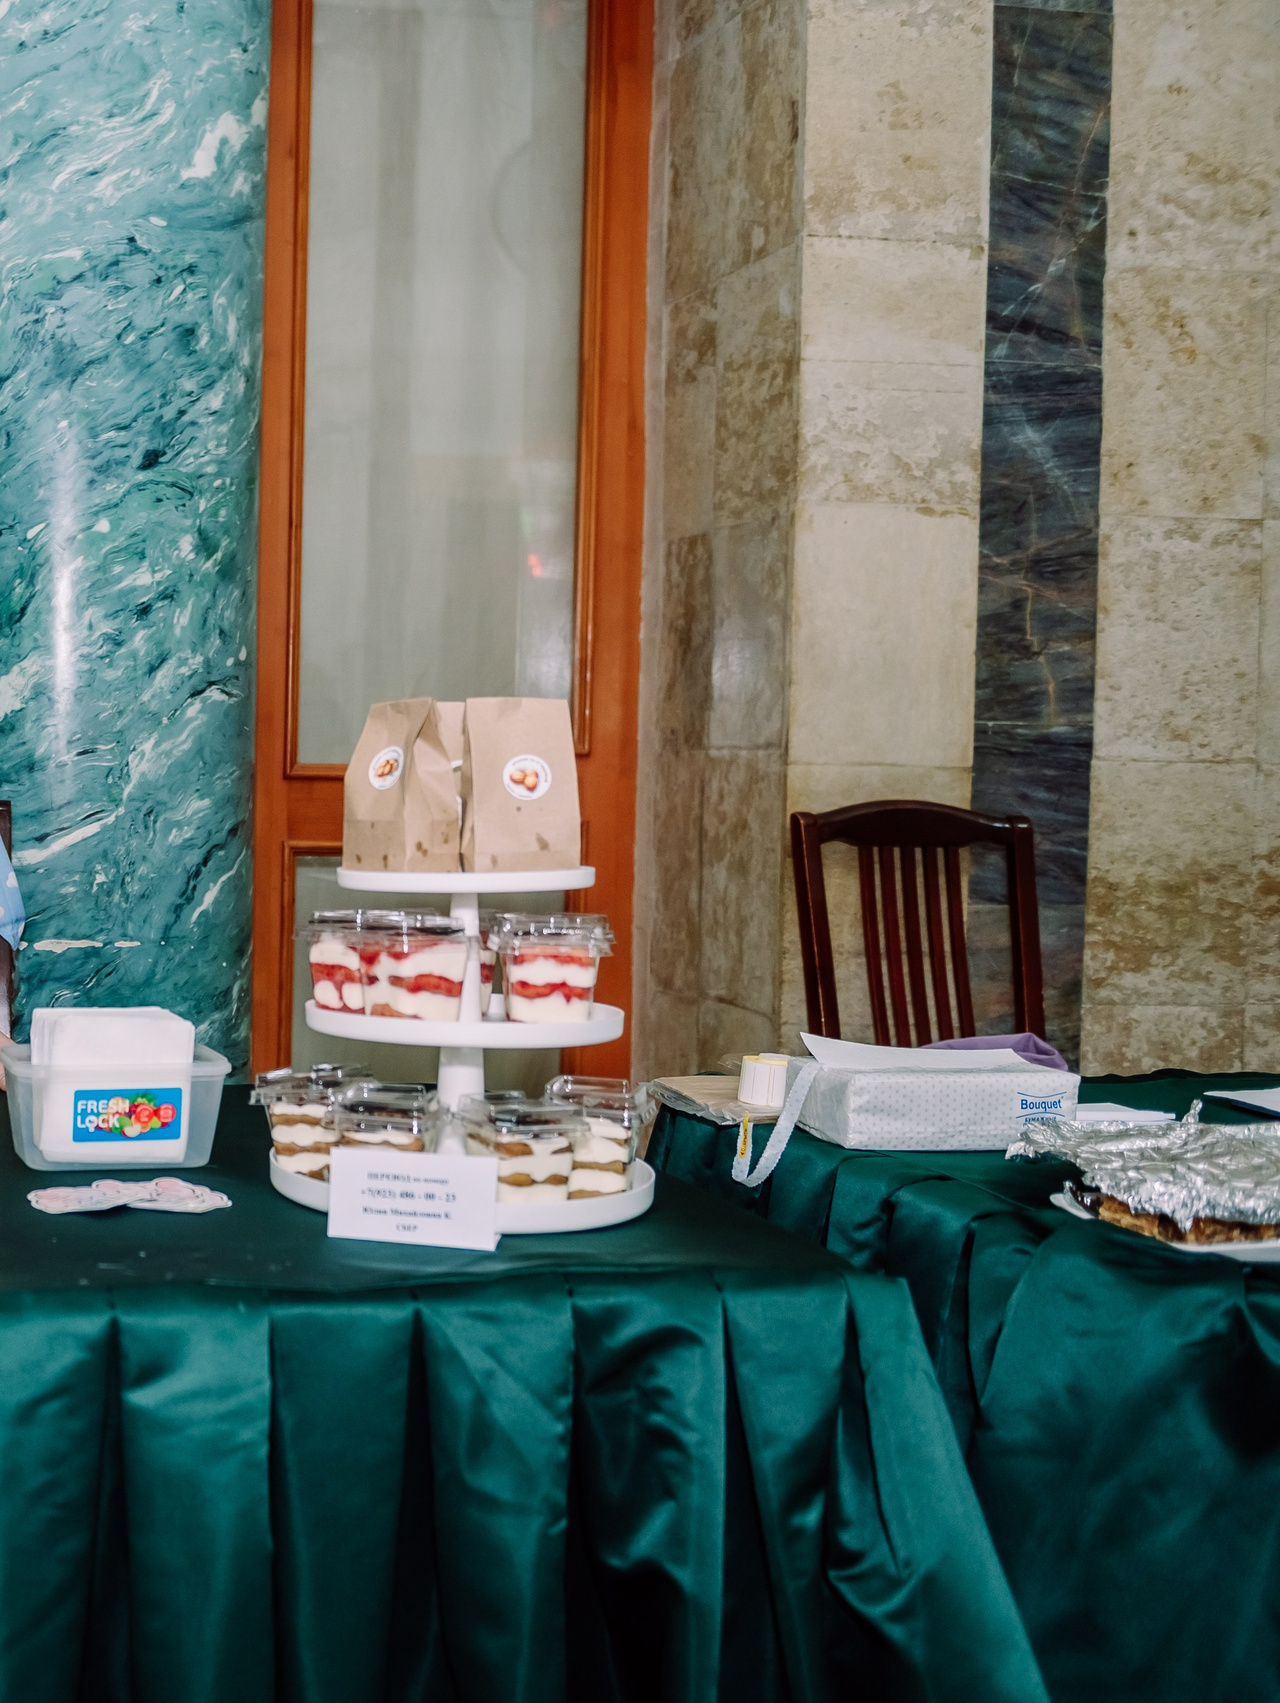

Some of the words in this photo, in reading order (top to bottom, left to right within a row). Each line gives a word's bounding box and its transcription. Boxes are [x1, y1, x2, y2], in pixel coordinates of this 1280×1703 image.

[77, 1099, 130, 1114] FRESH
[1020, 1098, 1062, 1112] Bouquet
[76, 1113, 120, 1132] LOCK
